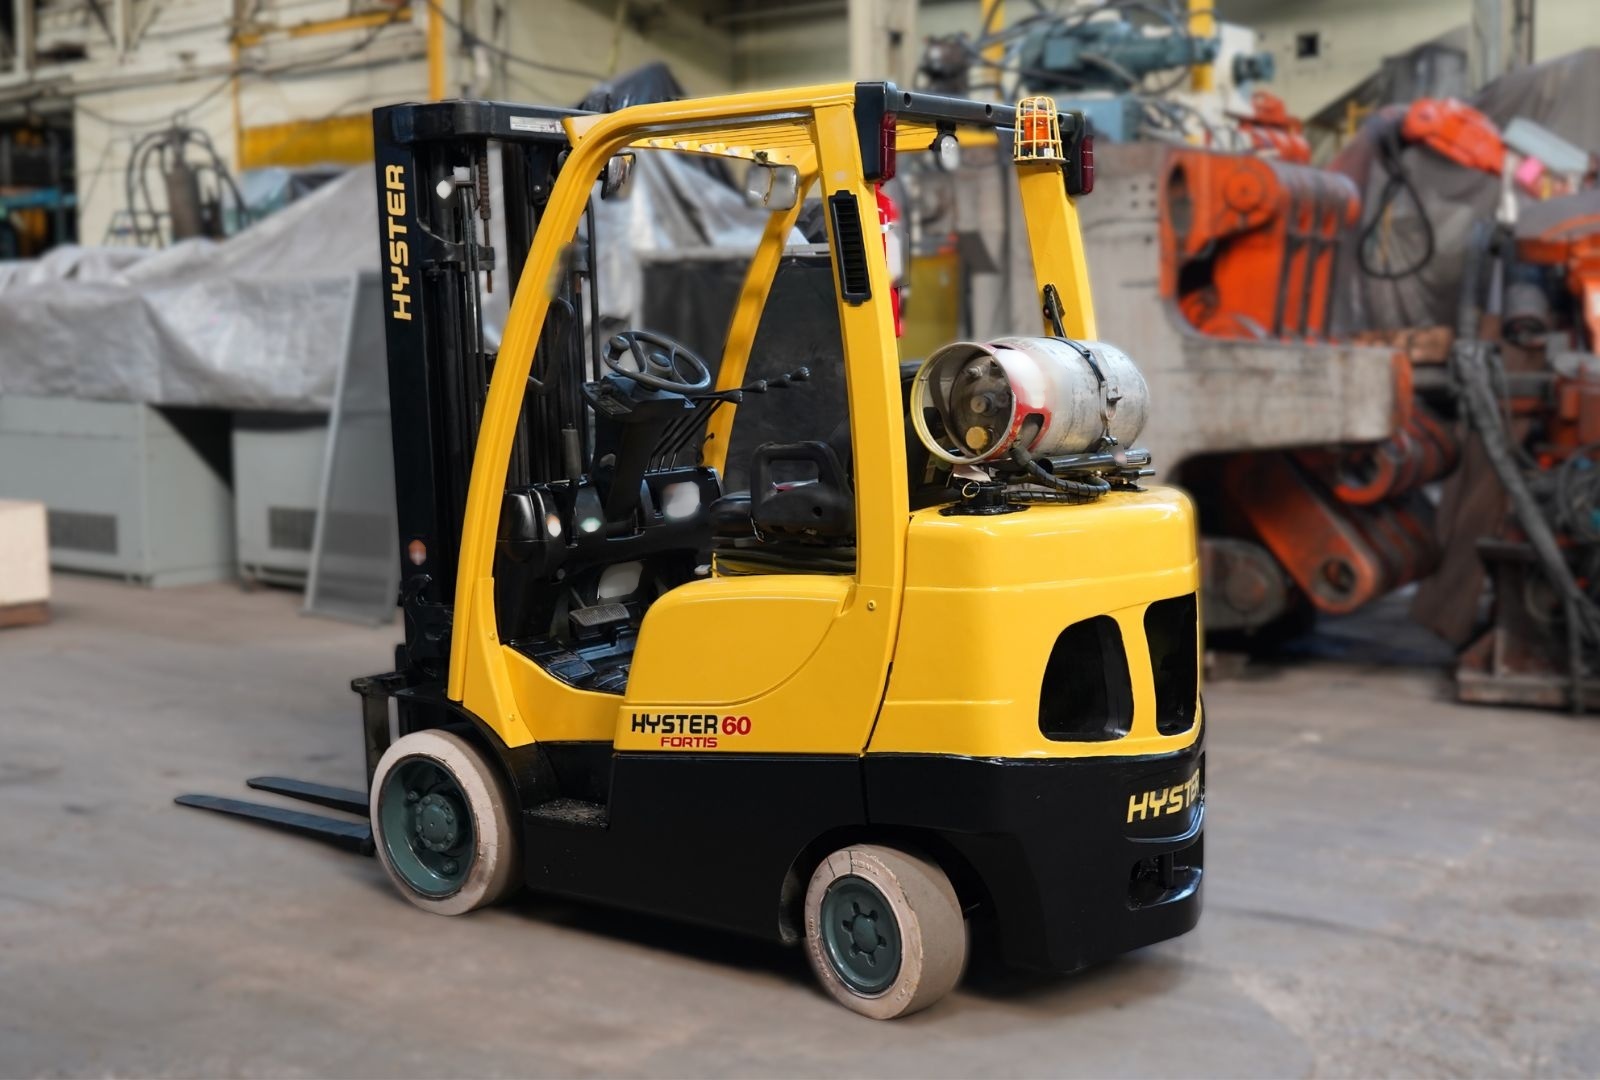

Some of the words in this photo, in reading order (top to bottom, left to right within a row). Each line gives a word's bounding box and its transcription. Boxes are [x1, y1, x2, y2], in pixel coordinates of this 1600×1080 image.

[385, 164, 412, 321] HYSTER
[631, 713, 718, 735] HYSTER
[721, 716, 752, 736] 60
[660, 737, 718, 748] FORTIS
